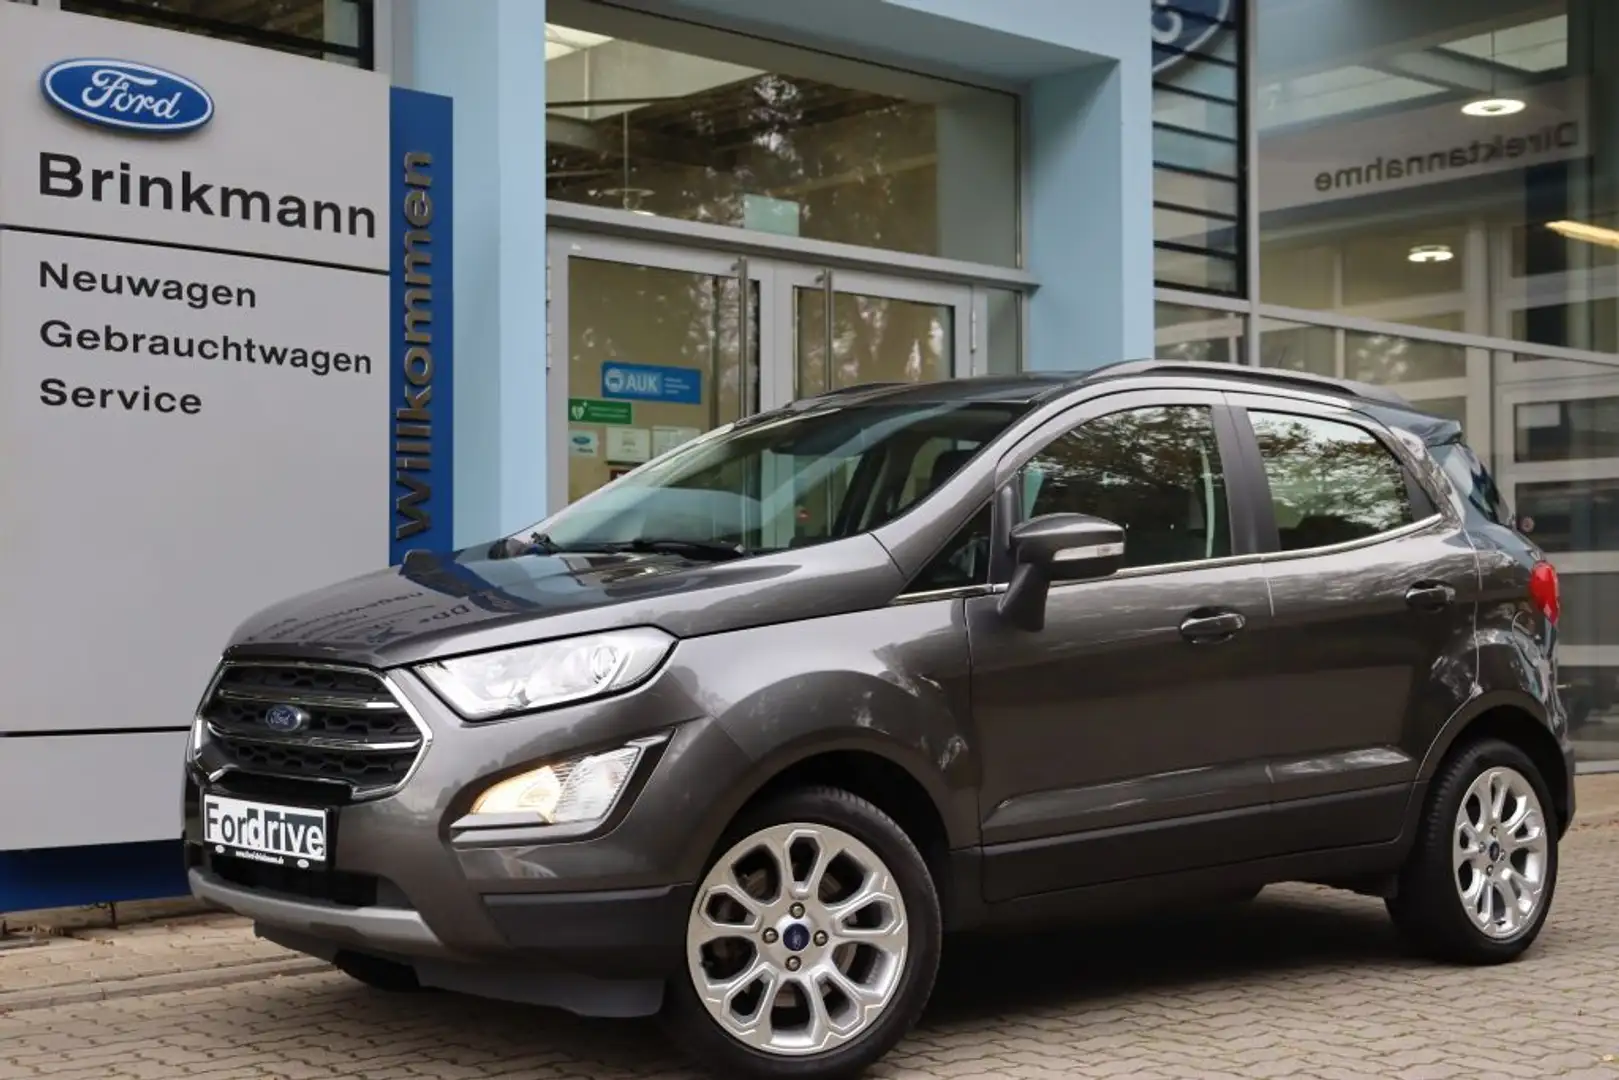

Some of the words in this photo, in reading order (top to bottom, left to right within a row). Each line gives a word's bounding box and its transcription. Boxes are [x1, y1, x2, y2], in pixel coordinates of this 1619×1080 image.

[81, 69, 181, 120] Ford
[39, 151, 376, 239] Brinkmann
[39, 261, 257, 309] Neuwagen
[39, 319, 373, 376] Gebrauchtwagen
[39, 378, 203, 415] Service
[626, 373, 658, 393] AUK
[205, 802, 324, 856] Fordrive
